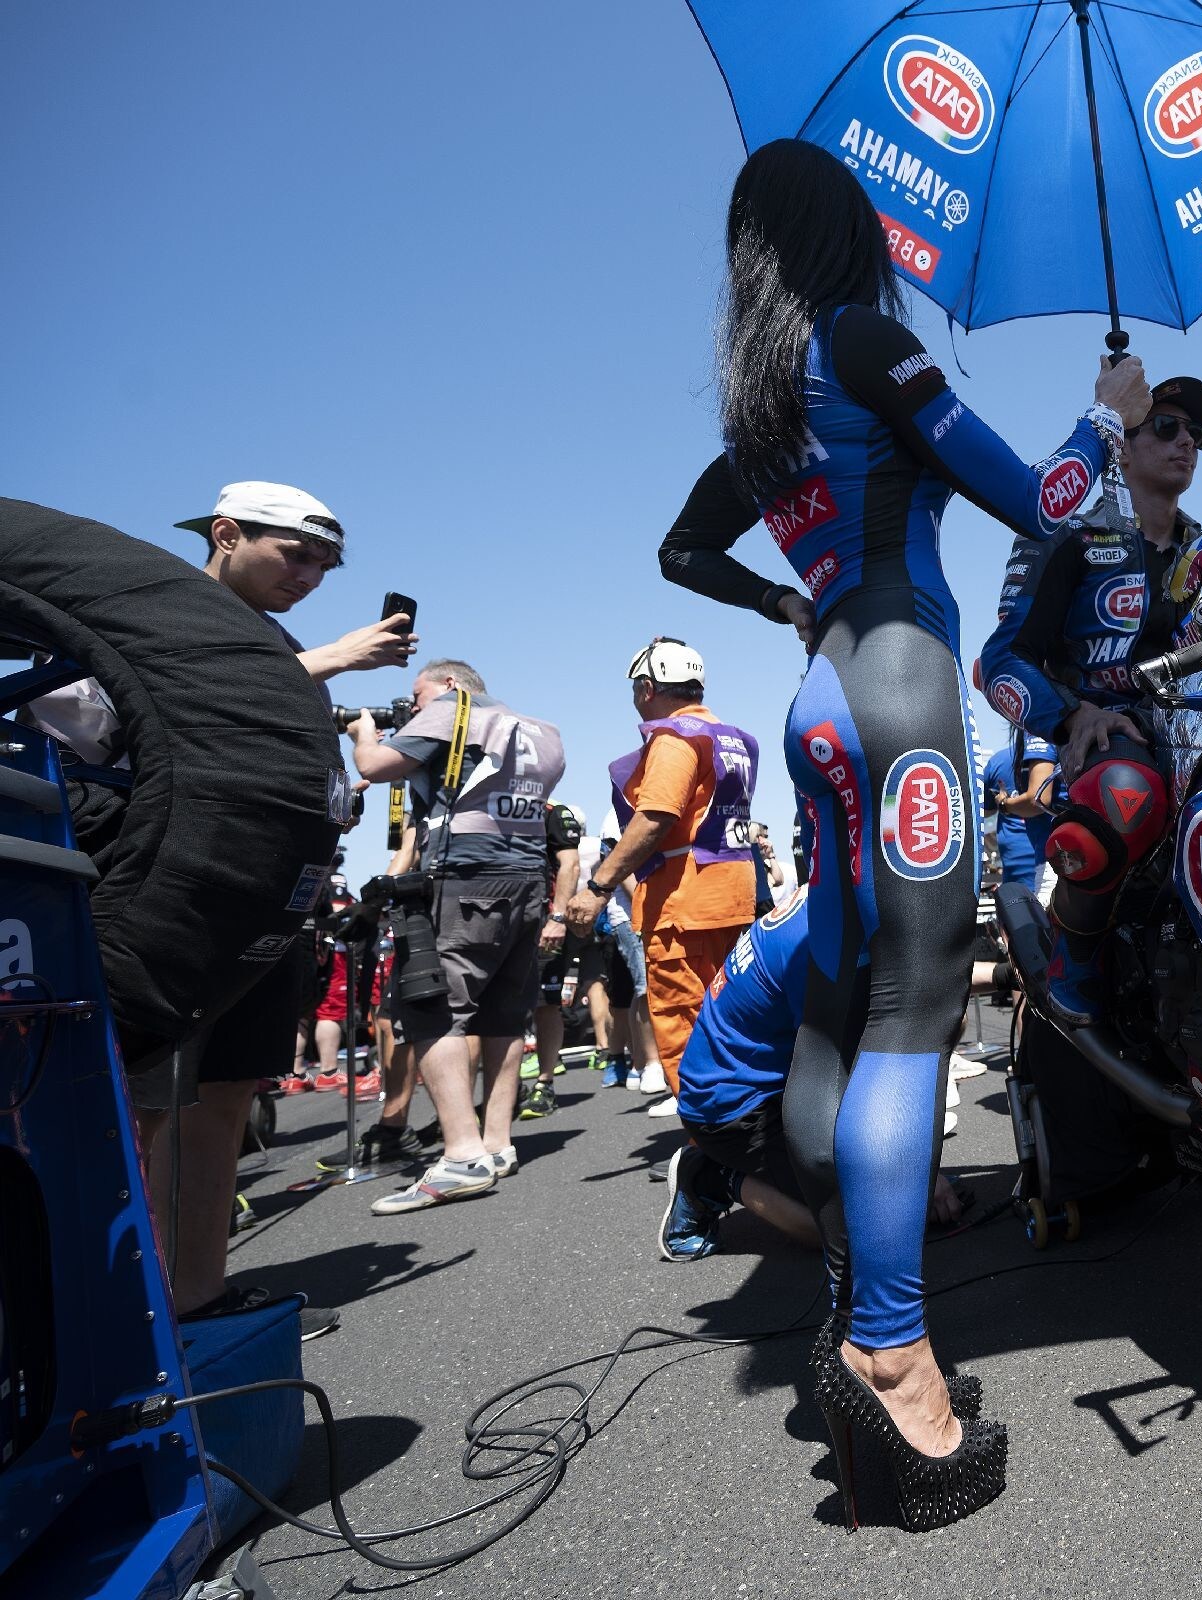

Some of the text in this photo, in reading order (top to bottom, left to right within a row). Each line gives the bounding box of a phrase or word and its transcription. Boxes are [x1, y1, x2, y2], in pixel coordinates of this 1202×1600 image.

[1044, 471, 1085, 512] PATA
[1092, 551, 1121, 560] SHOEI
[1116, 595, 1142, 613] PA
[1087, 635, 1136, 665] YAM
[686, 662, 703, 672] 107
[508, 779, 544, 795] PHOTO
[911, 778, 940, 854] PATA
[949, 786, 962, 842] SNACK
